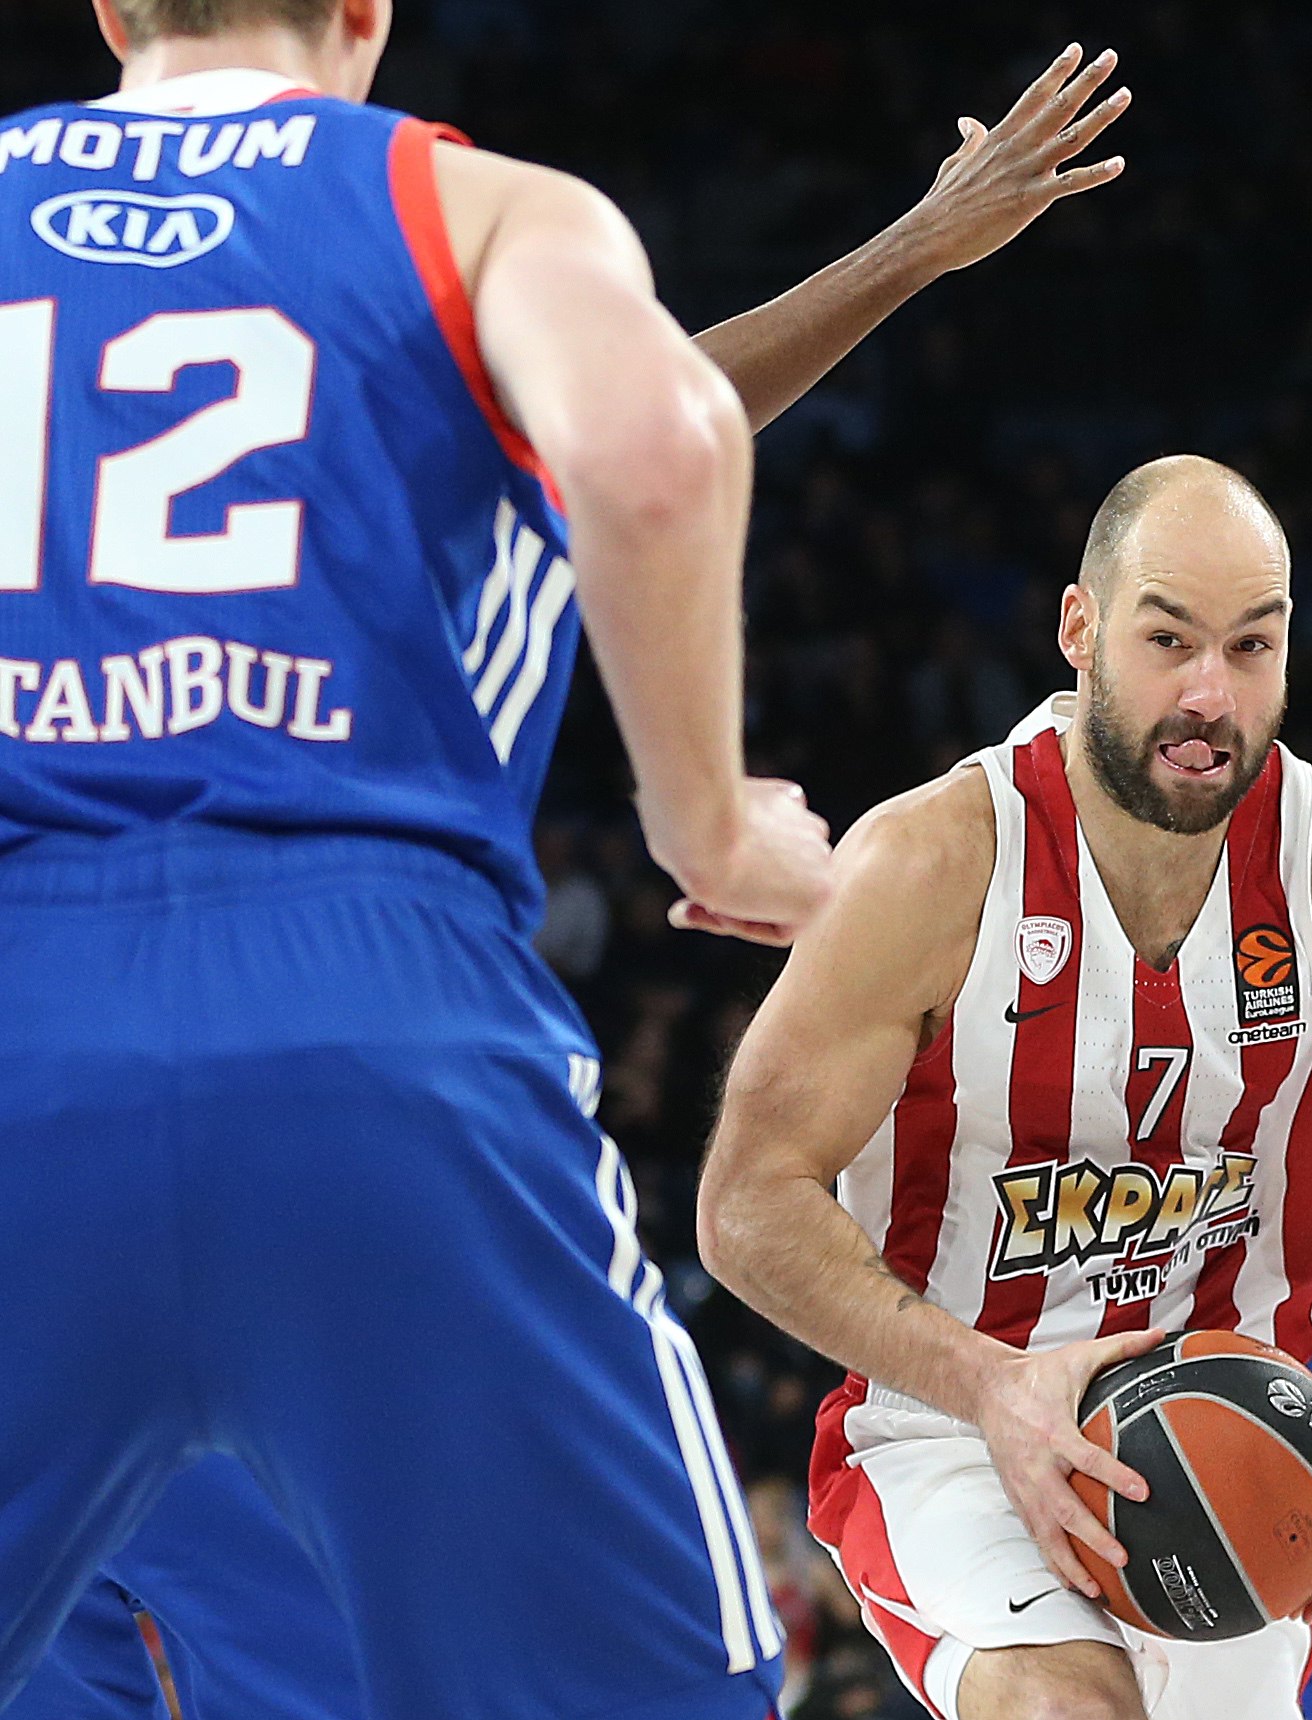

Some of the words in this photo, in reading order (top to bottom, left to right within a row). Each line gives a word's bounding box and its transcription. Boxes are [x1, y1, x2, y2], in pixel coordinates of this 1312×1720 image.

[0, 114, 318, 182] MOTUM
[66, 203, 201, 253] KIA
[0, 299, 316, 593] 12
[1243, 985, 1294, 1001] TURKISH
[1245, 995, 1295, 1011] AIRLINES
[1228, 1022, 1307, 1044] oneteam
[1137, 1047, 1189, 1141] 7
